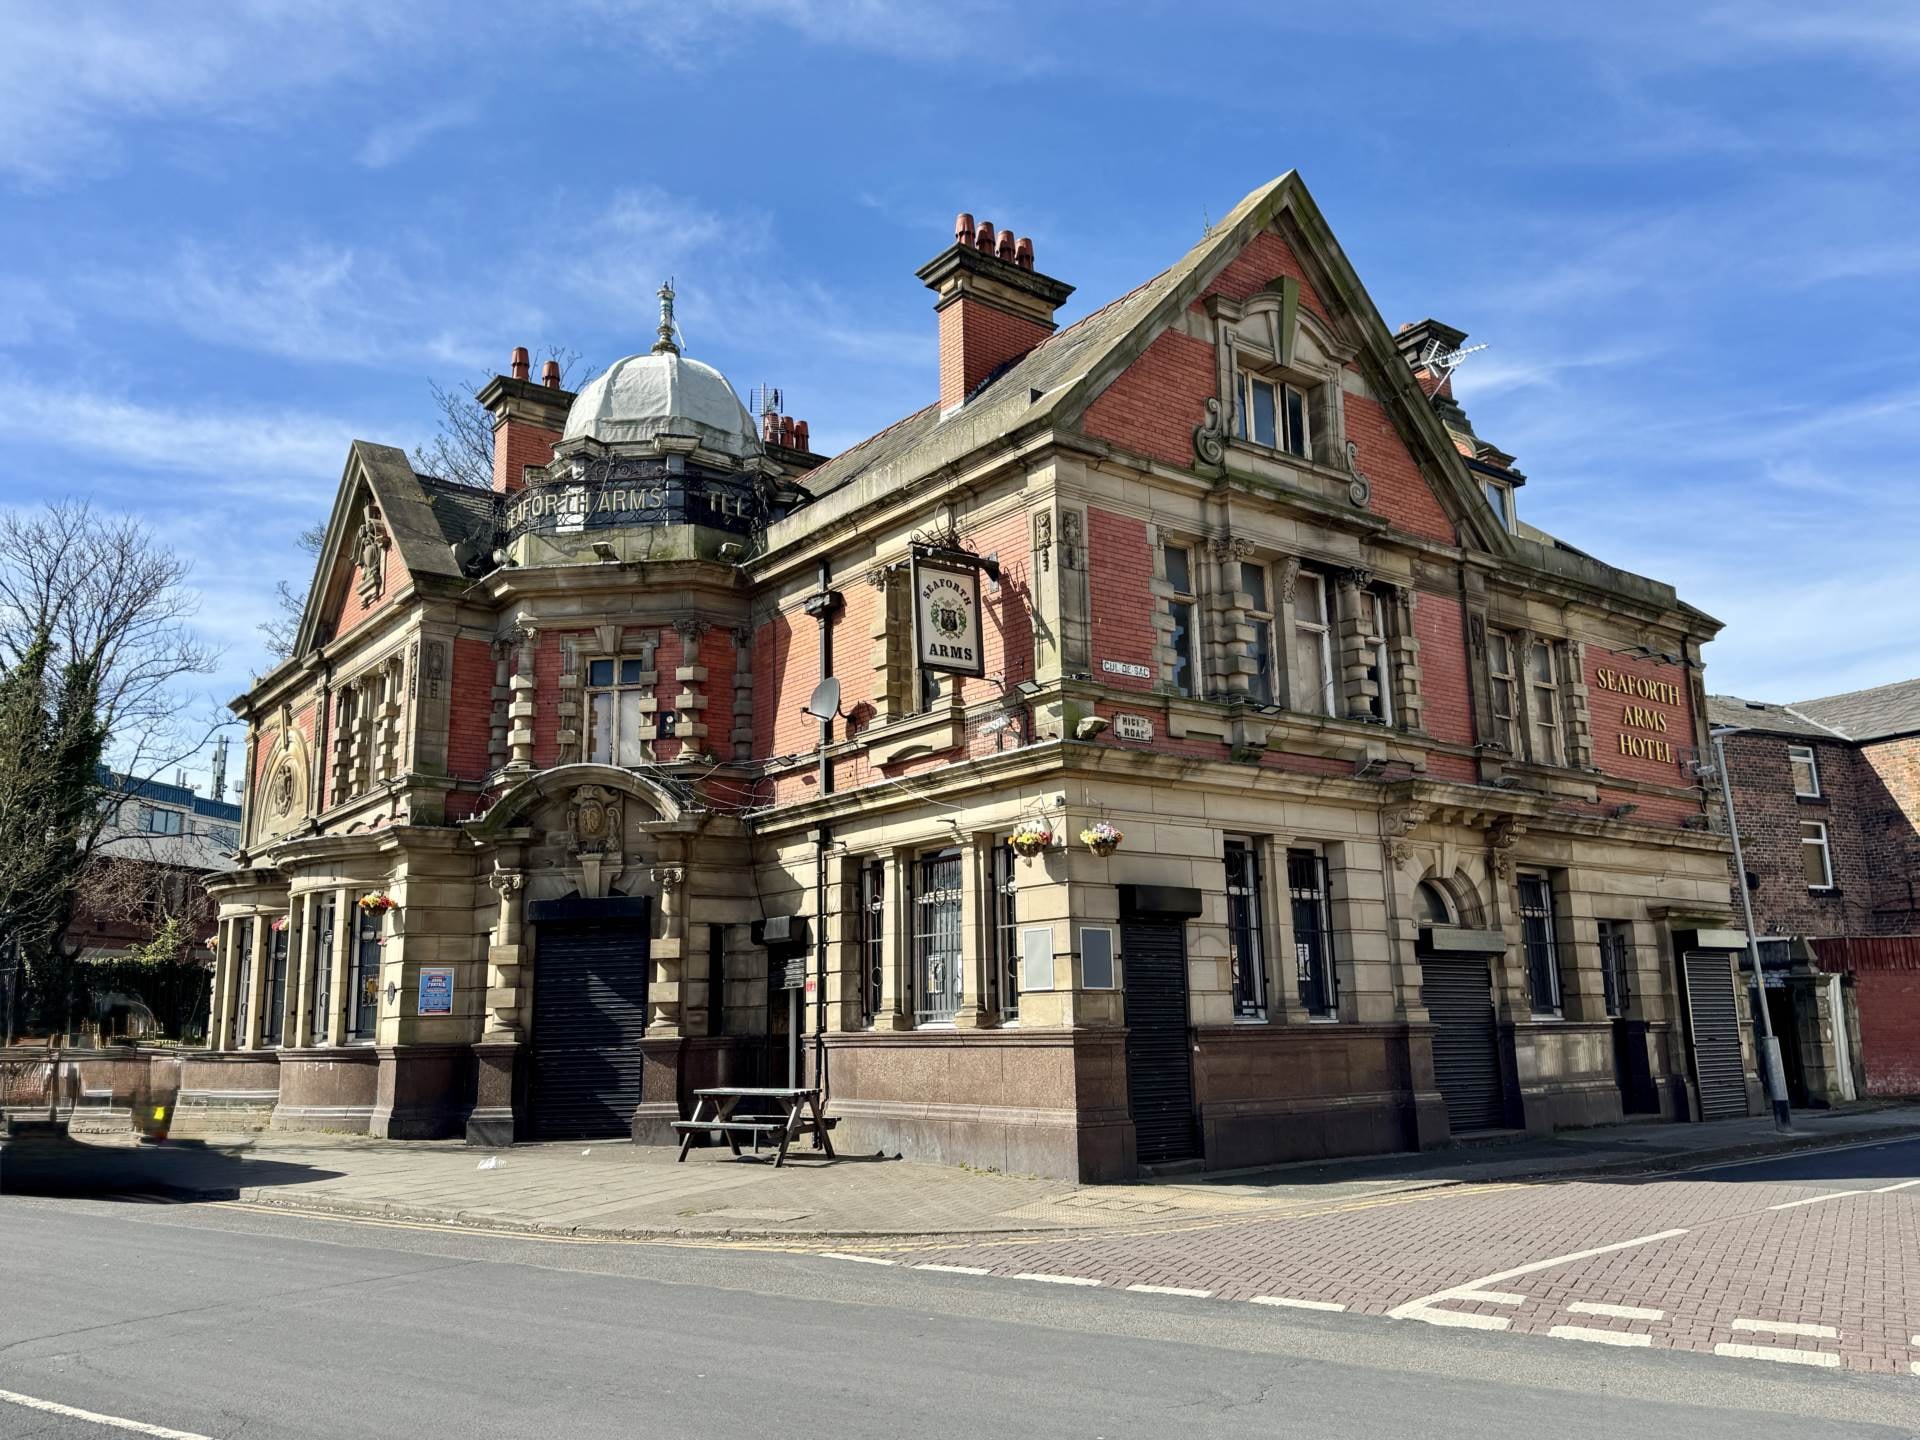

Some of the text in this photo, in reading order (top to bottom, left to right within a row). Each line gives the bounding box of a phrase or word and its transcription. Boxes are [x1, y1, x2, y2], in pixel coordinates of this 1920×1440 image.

[598, 488, 664, 512] ARMS
[922, 579, 972, 605] SEAFORTH
[929, 643, 973, 660] ARMS
[1597, 668, 1681, 706] SEAFORTH
[1624, 705, 1667, 733] ARMS
[1620, 733, 1675, 764] HOTEL
